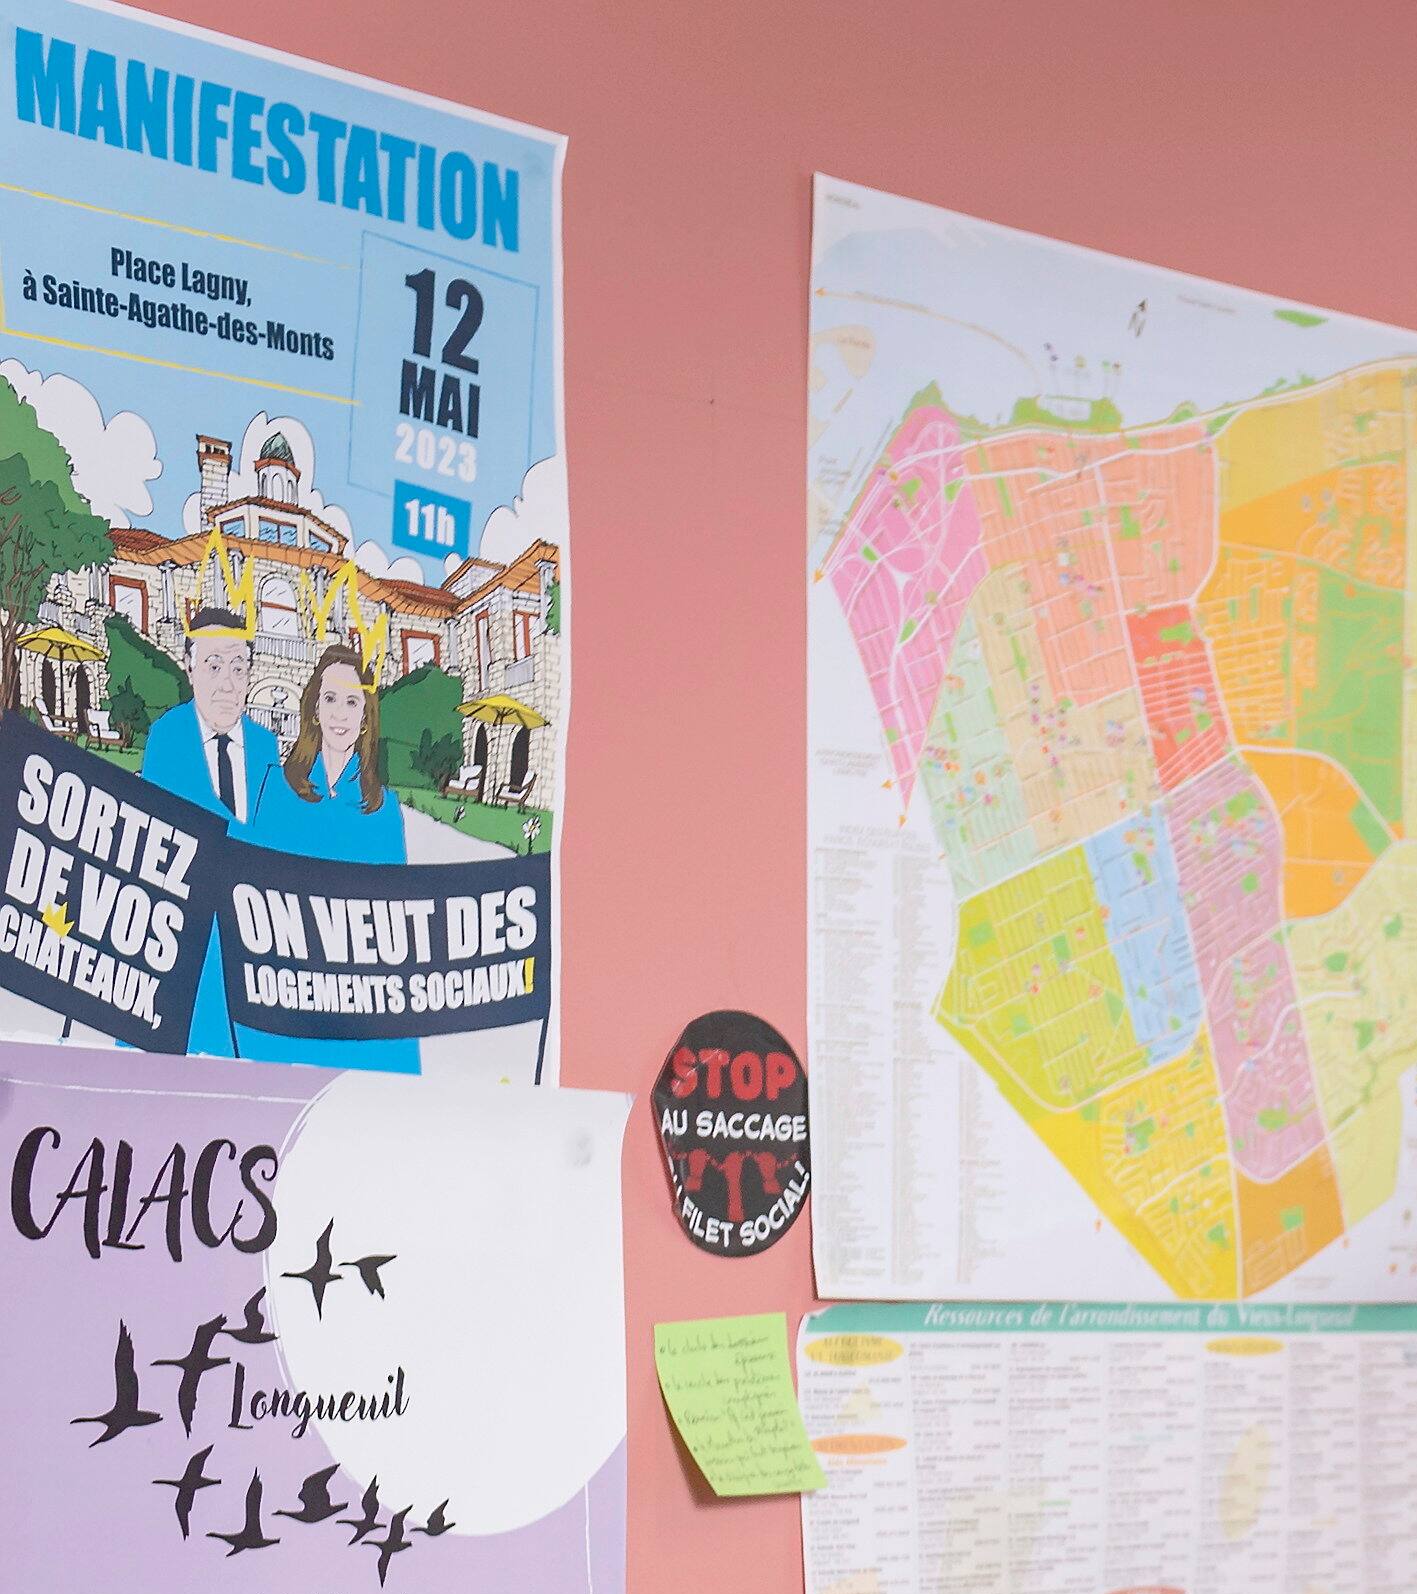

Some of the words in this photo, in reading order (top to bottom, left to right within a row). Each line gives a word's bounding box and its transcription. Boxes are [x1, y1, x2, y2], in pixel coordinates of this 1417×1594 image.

[16, 27, 519, 252] MANIFESTATION
[23, 269, 37, 301] à
[43, 273, 335, 361] Sainte-Agathe-des-Monts
[111, 248, 176, 288] Place
[182, 261, 252, 307] Lagny,
[404, 268, 485, 374] 12
[400, 359, 481, 439] MAI
[395, 423, 477, 482] 2023
[404, 499, 455, 544] 11h
[17, 754, 198, 900] SORTEZ
[4, 827, 74, 913] DE
[82, 859, 185, 972] VOS
[232, 882, 308, 960] ON
[309, 896, 434, 966] VEUT
[446, 885, 539, 961] DES
[244, 962, 406, 1015] LOGEMENTS
[410, 956, 534, 1012] SOCIAUX!
[670, 1046, 797, 1101] STOP
[661, 1108, 688, 1137] AU
[696, 1110, 807, 1142] SACCAGE
[11, 1127, 279, 1262] CALACS
[681, 1197, 734, 1247] FILET
[924, 1304, 1022, 1327] Ressources
[1030, 1304, 1052, 1326] de
[227, 1362, 410, 1438] Longueuil
